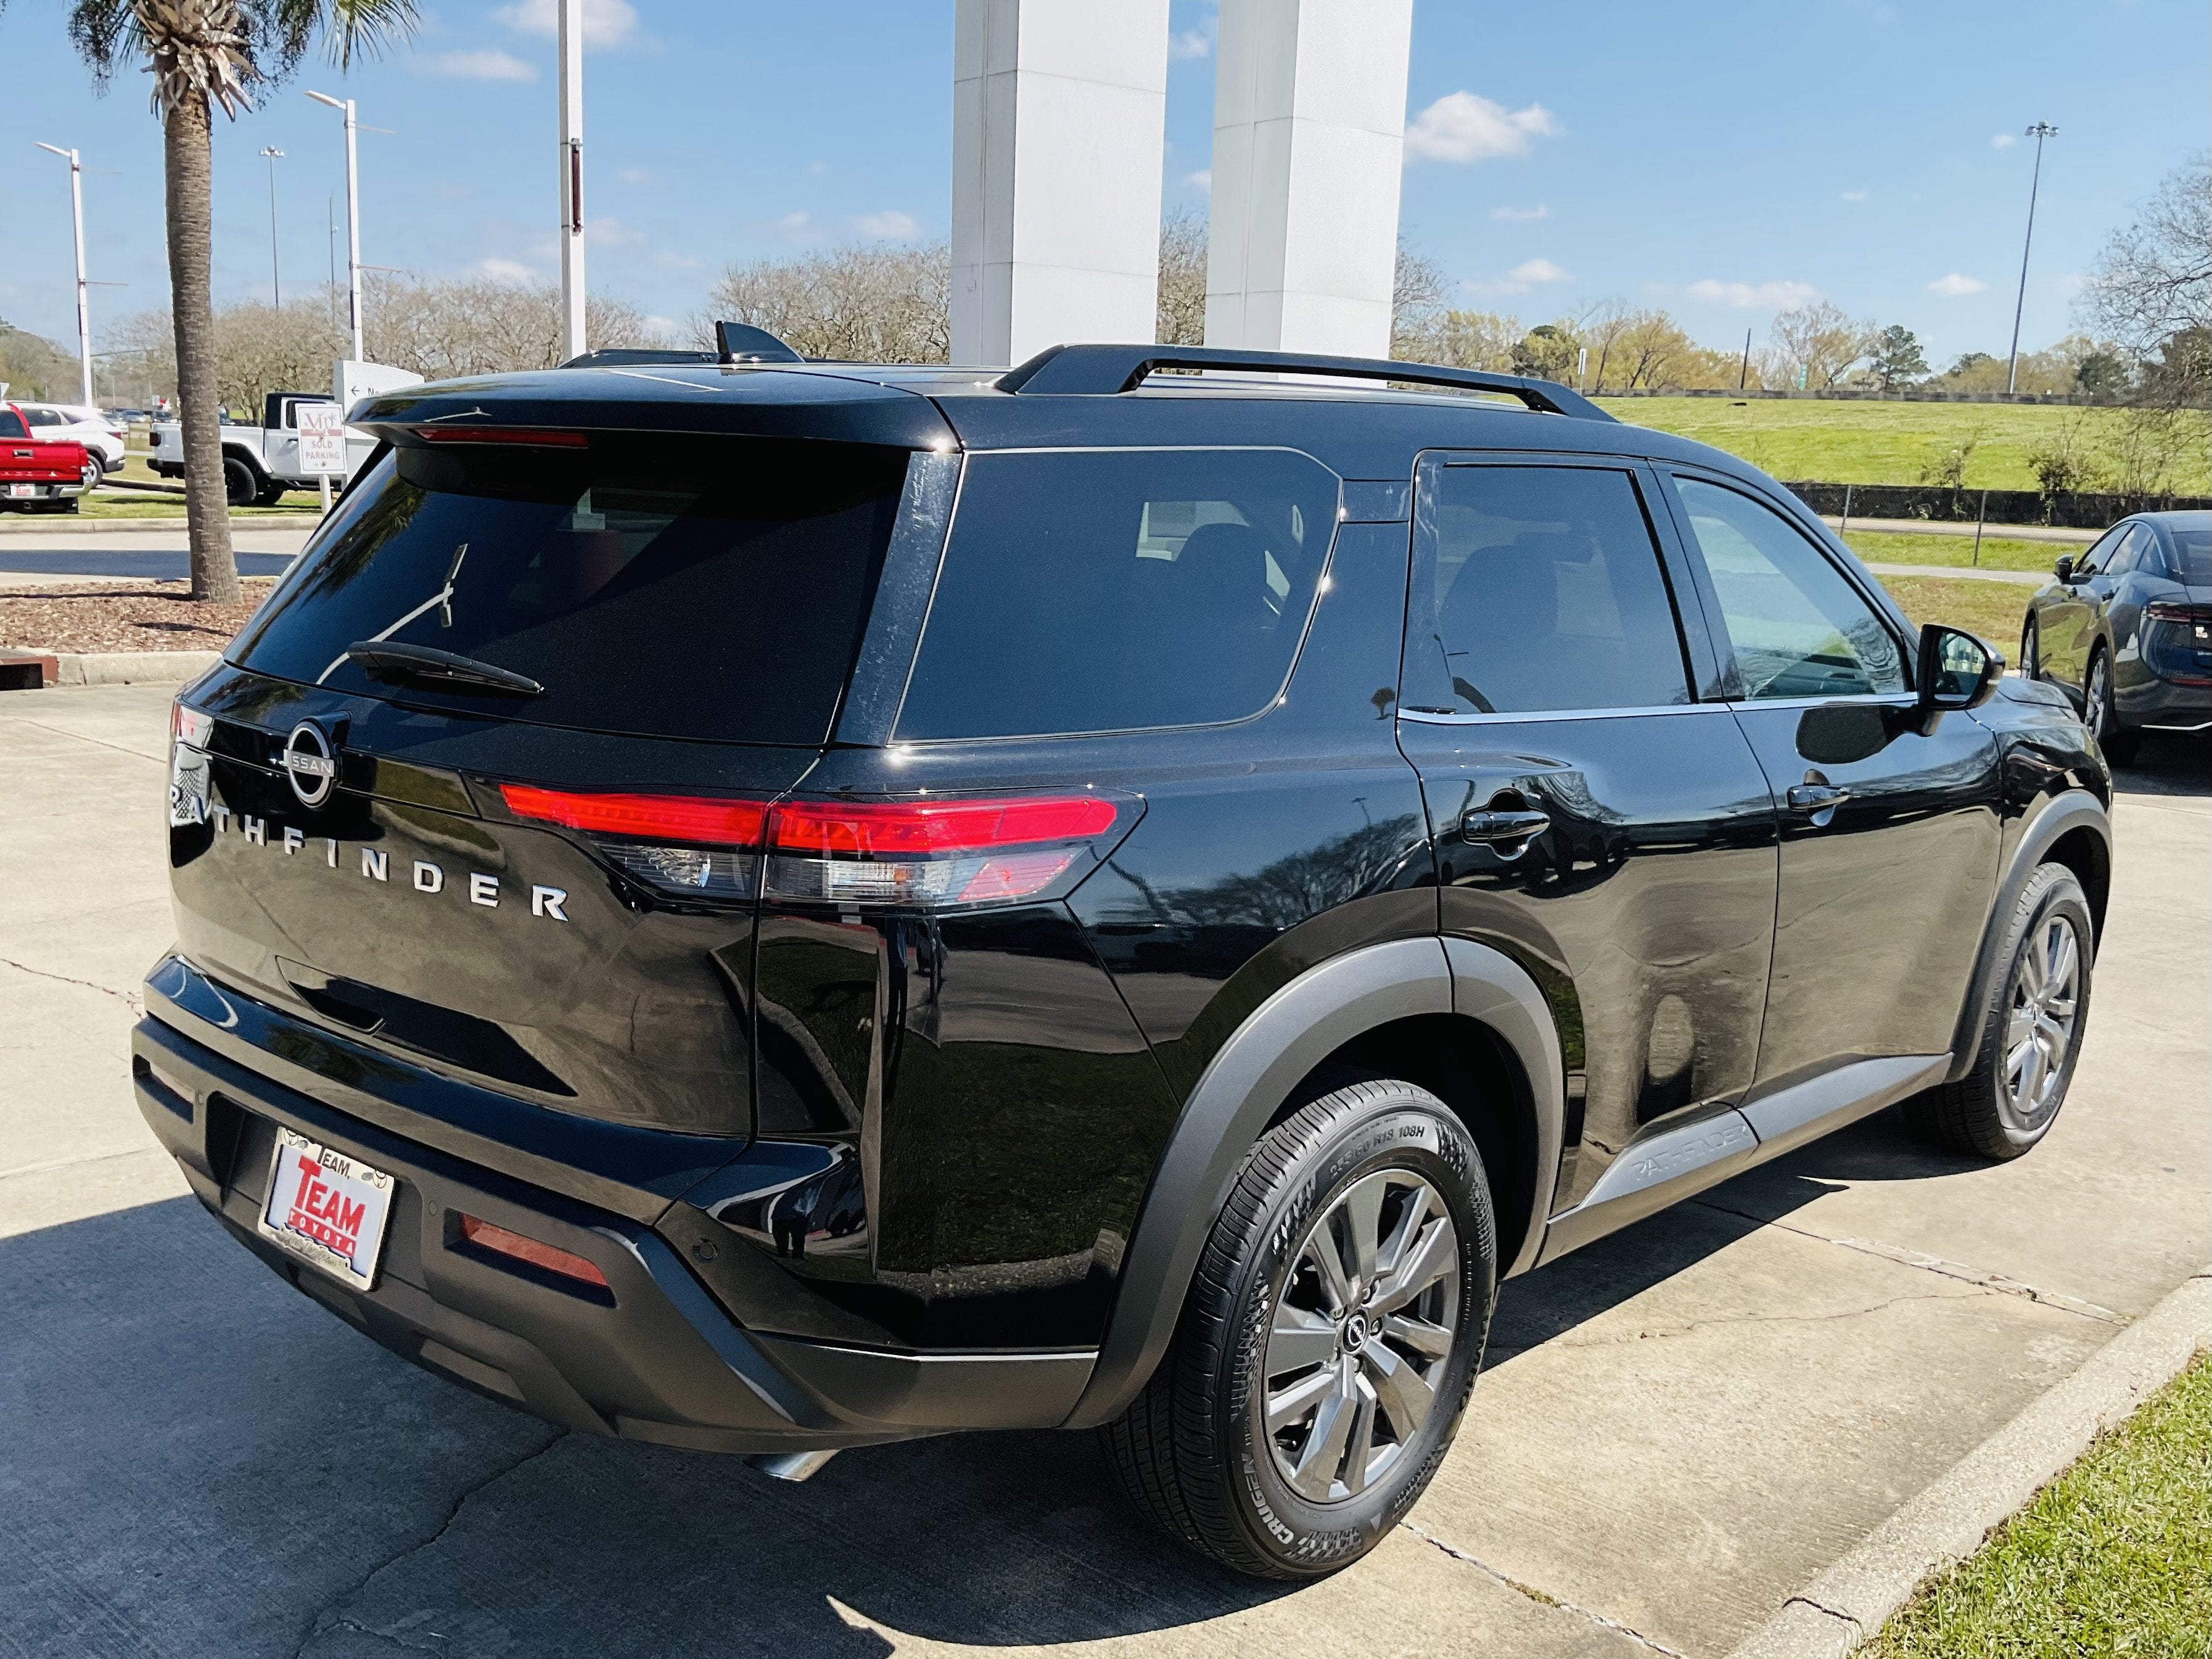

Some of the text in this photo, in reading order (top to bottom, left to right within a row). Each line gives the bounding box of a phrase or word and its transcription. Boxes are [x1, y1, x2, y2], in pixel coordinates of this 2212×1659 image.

[305, 451, 340, 459] PARKING
[311, 440, 333, 449] SOLD
[170, 784, 569, 922] PATHFINDER
[1399, 1126, 1425, 1138] 108H
[295, 1155, 366, 1237] TEAM
[289, 1212, 353, 1255] TOYOTA
[1241, 1452, 1294, 1544] CRUGEN
